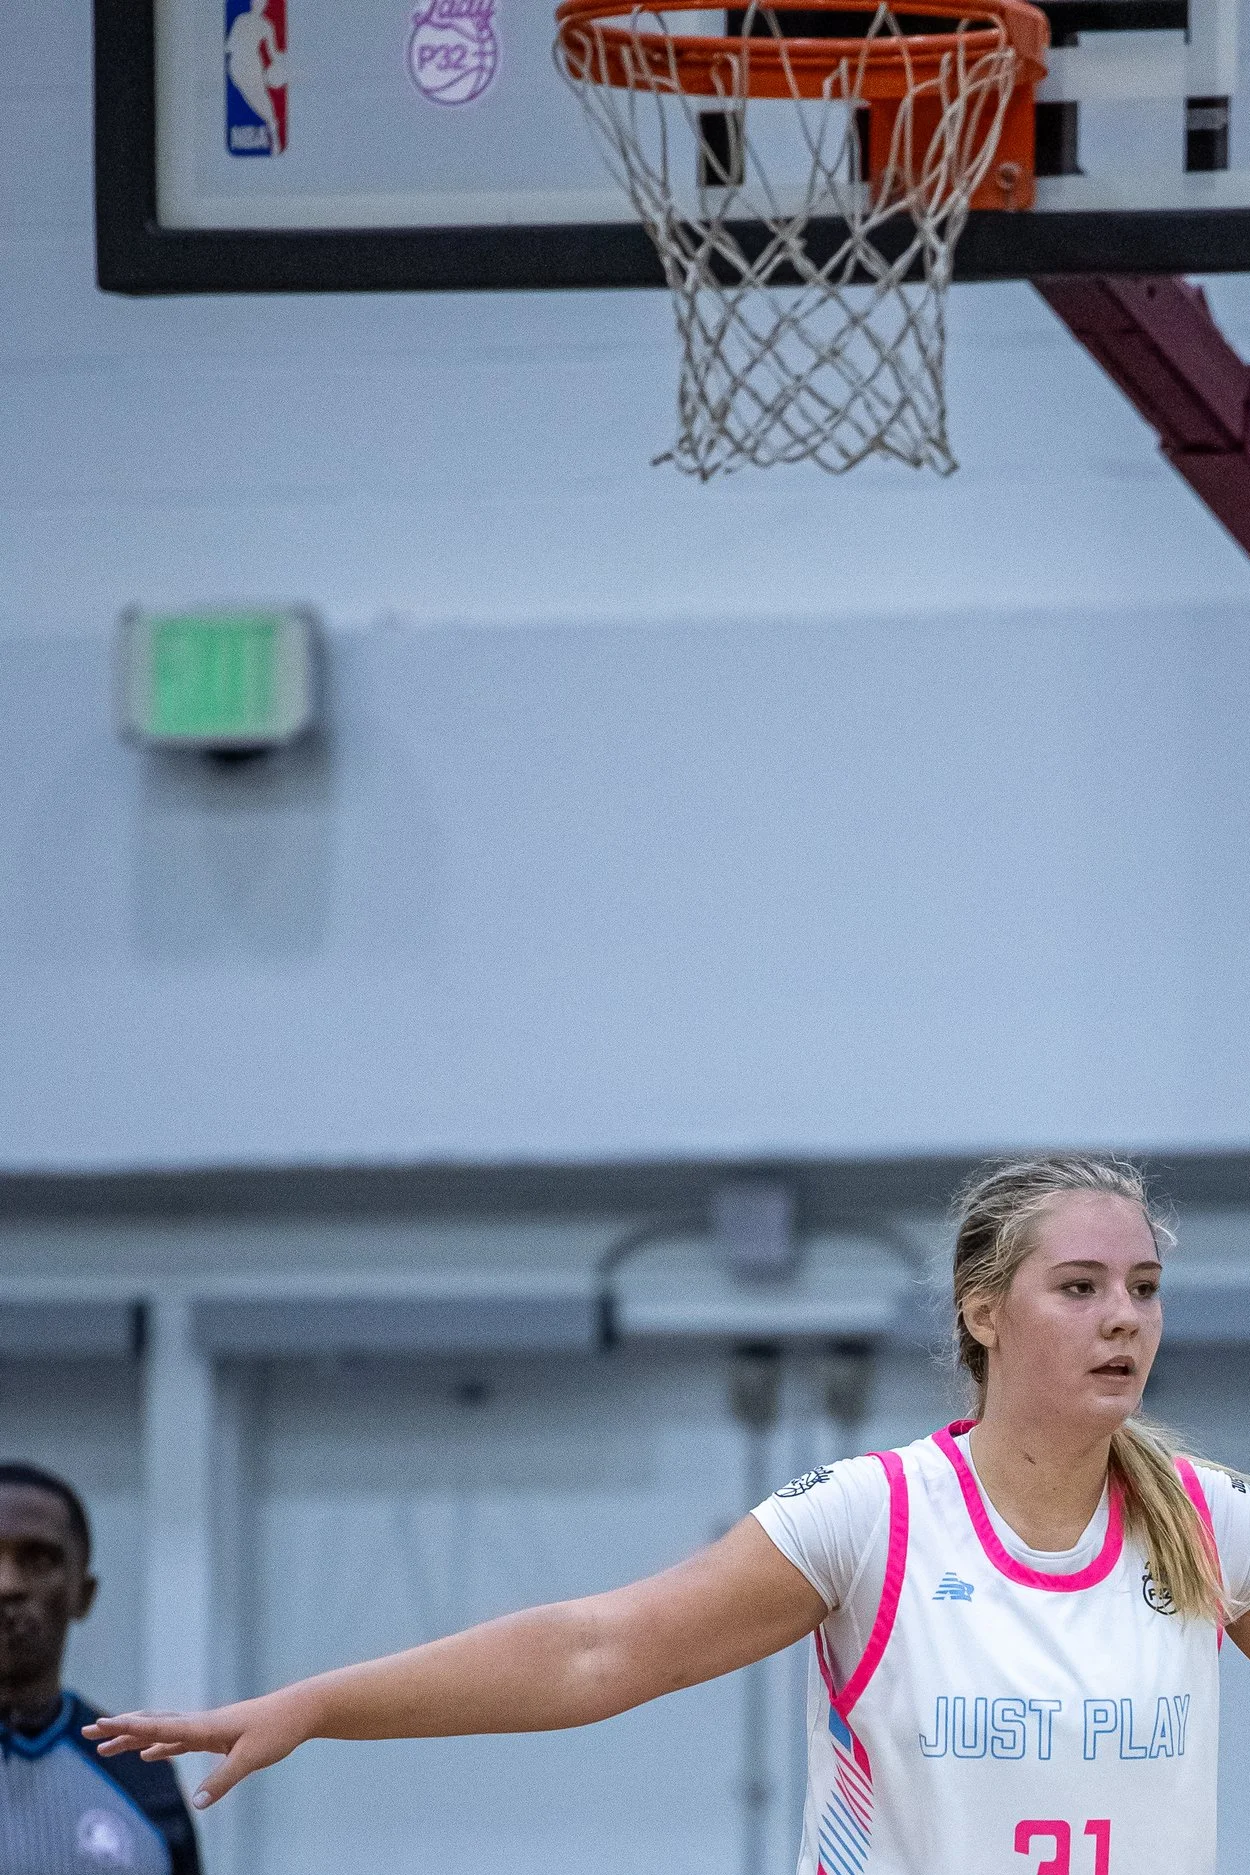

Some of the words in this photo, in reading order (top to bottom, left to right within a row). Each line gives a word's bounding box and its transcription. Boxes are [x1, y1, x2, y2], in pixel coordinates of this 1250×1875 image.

[418, 44, 467, 70] P32
[919, 1695, 1062, 1760] JUST
[1083, 1694, 1191, 1760] PLAY
